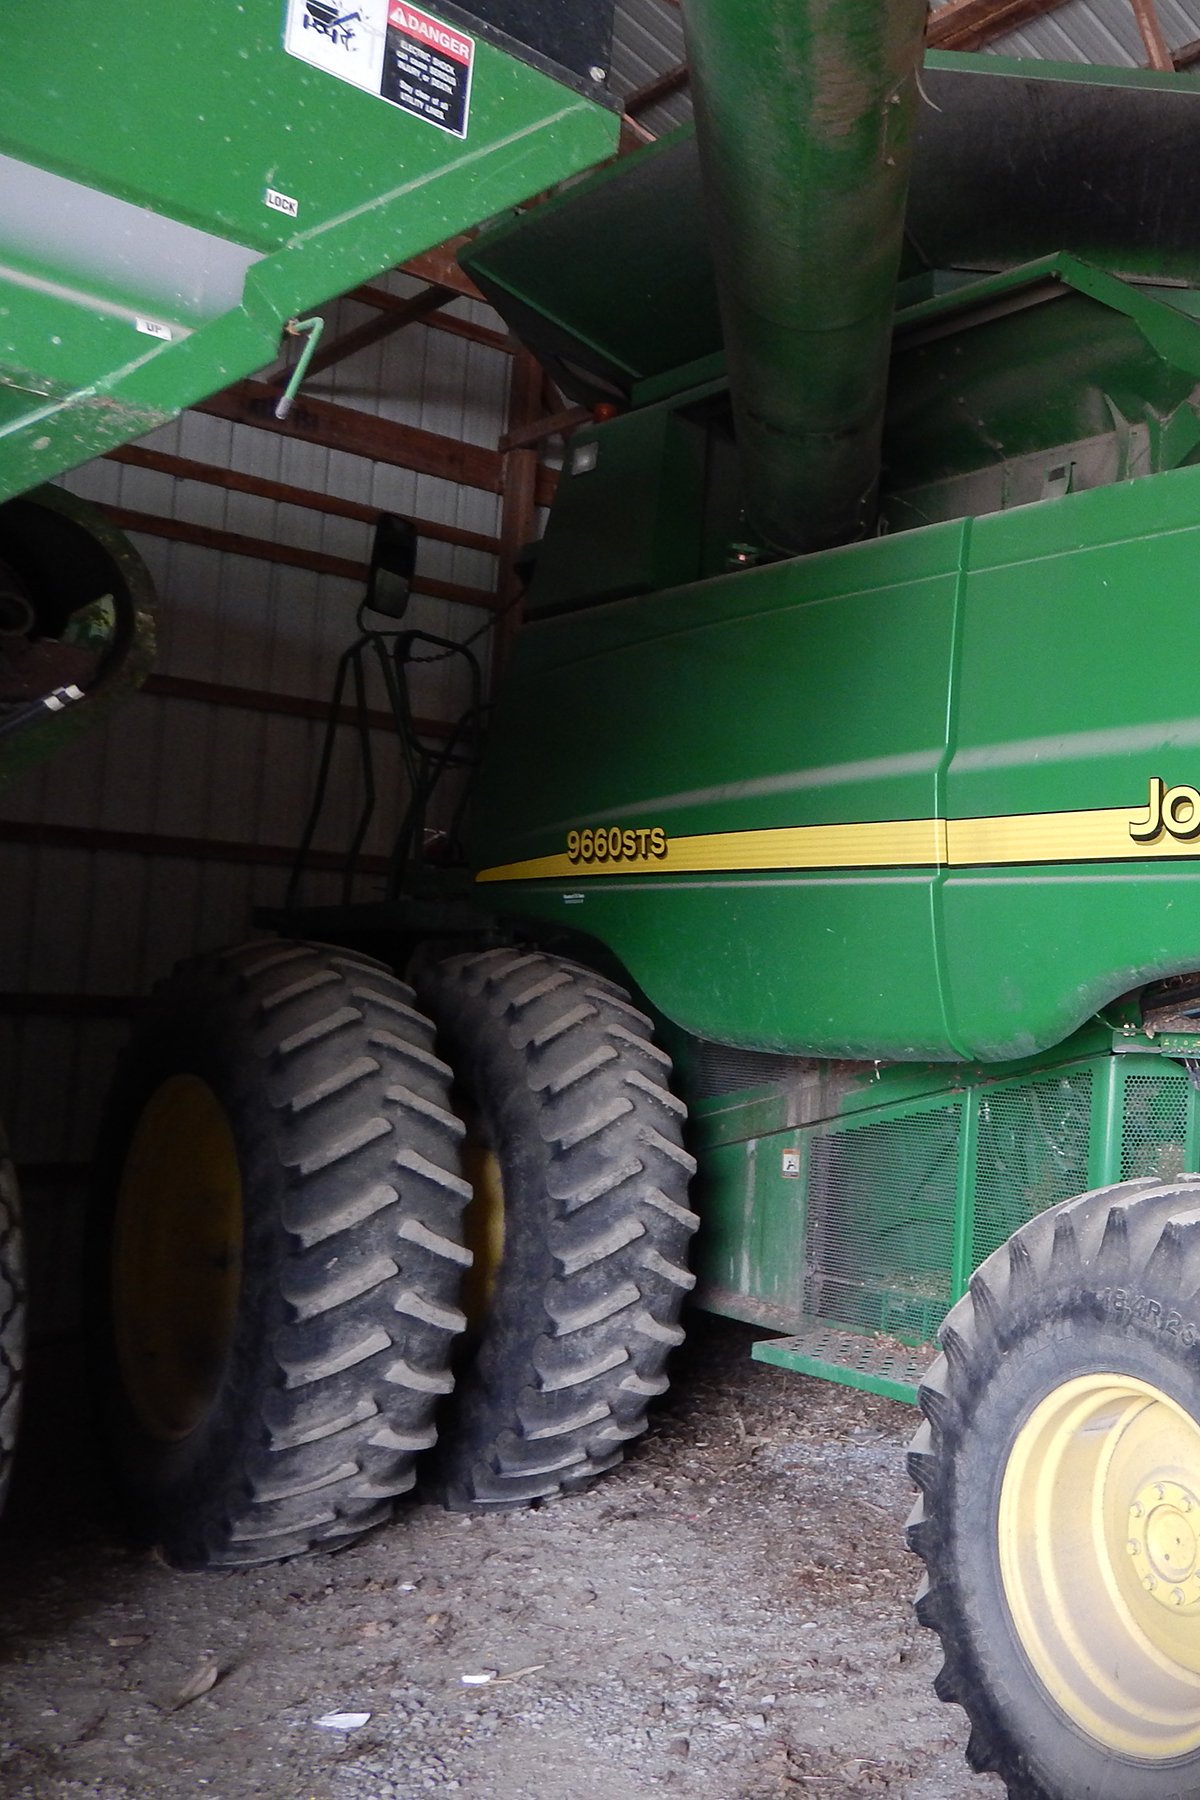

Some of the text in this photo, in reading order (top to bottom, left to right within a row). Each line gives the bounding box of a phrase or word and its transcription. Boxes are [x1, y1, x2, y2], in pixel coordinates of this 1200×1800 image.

[407, 13, 470, 60] DANGER
[268, 193, 296, 214] LOCK
[146, 321, 162, 333] UP
[567, 826, 669, 865] 9660STS
